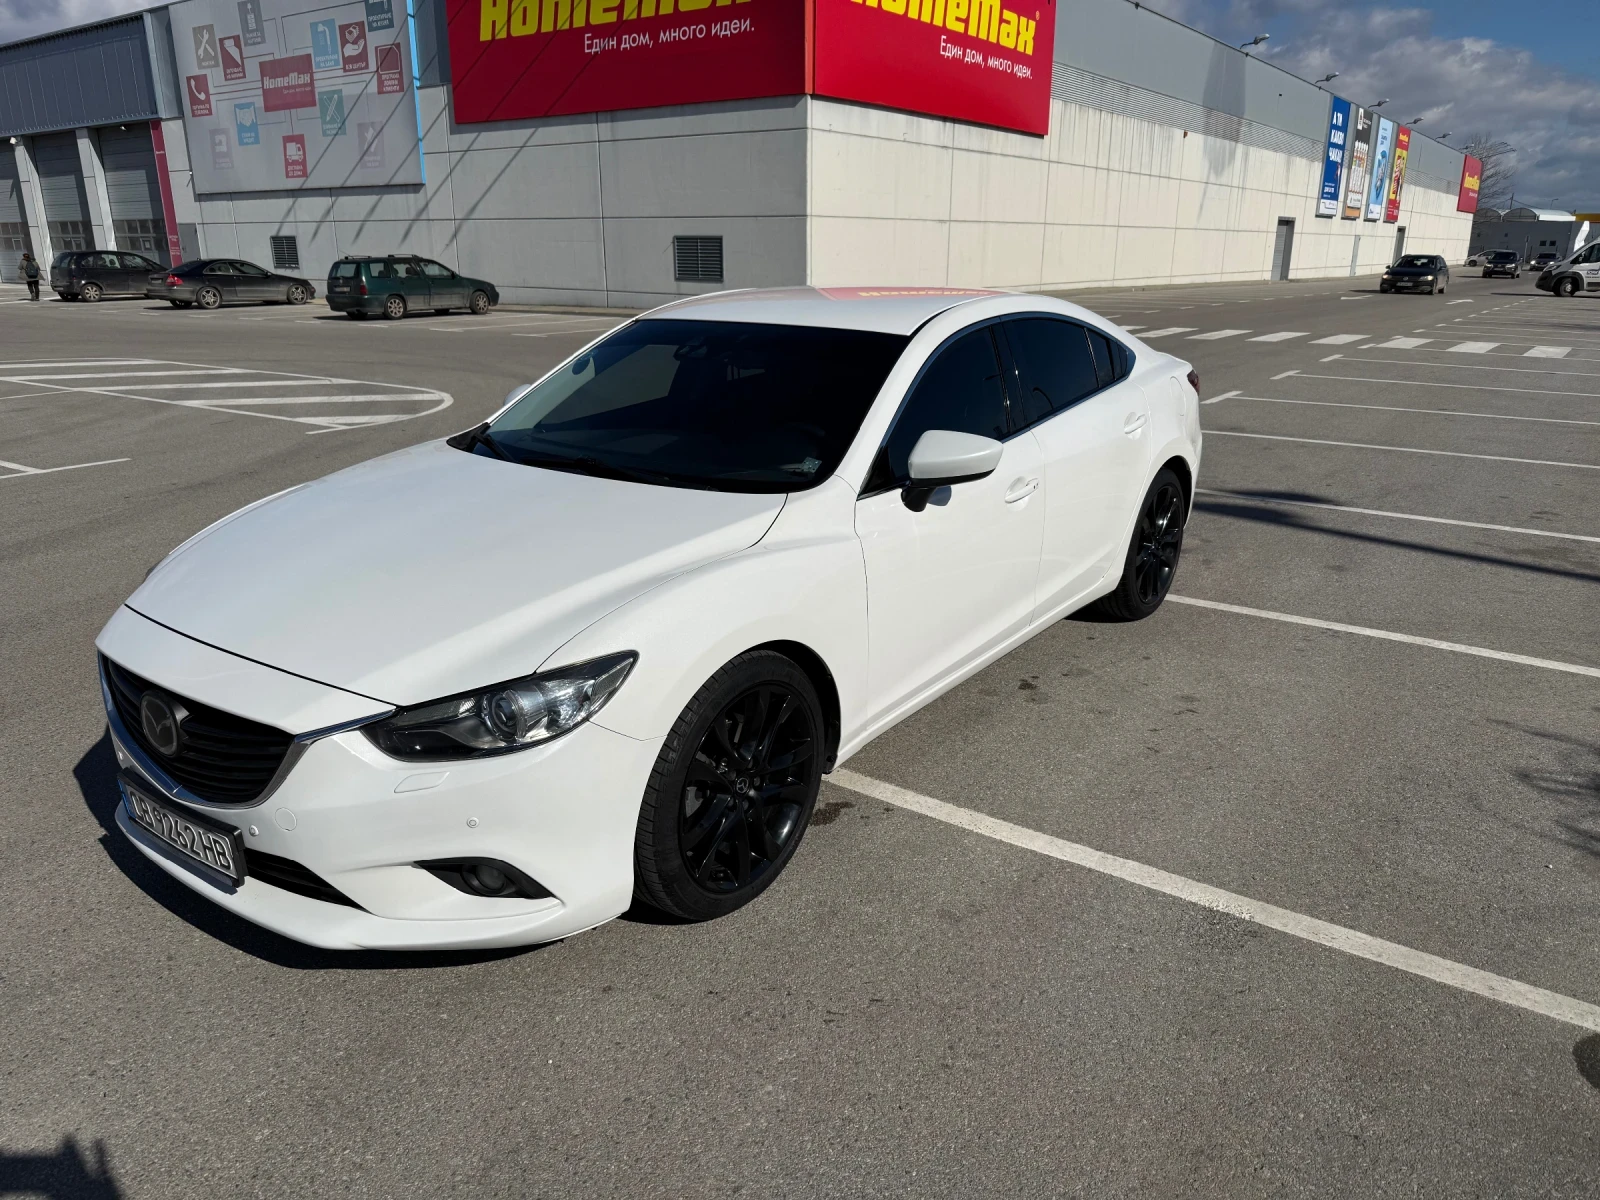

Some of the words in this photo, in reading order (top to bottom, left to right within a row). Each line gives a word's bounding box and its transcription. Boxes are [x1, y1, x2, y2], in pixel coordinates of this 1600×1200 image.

[584, 33, 617, 55] Един
[620, 32, 654, 52] дом,
[659, 27, 706, 43] много
[711, 18, 755, 36] идеи.
[940, 35, 963, 60] Един
[964, 48, 985, 69] дом,
[987, 55, 1012, 73] много
[1013, 63, 1033, 80] идеи.
[263, 72, 311, 89] HomeMax
